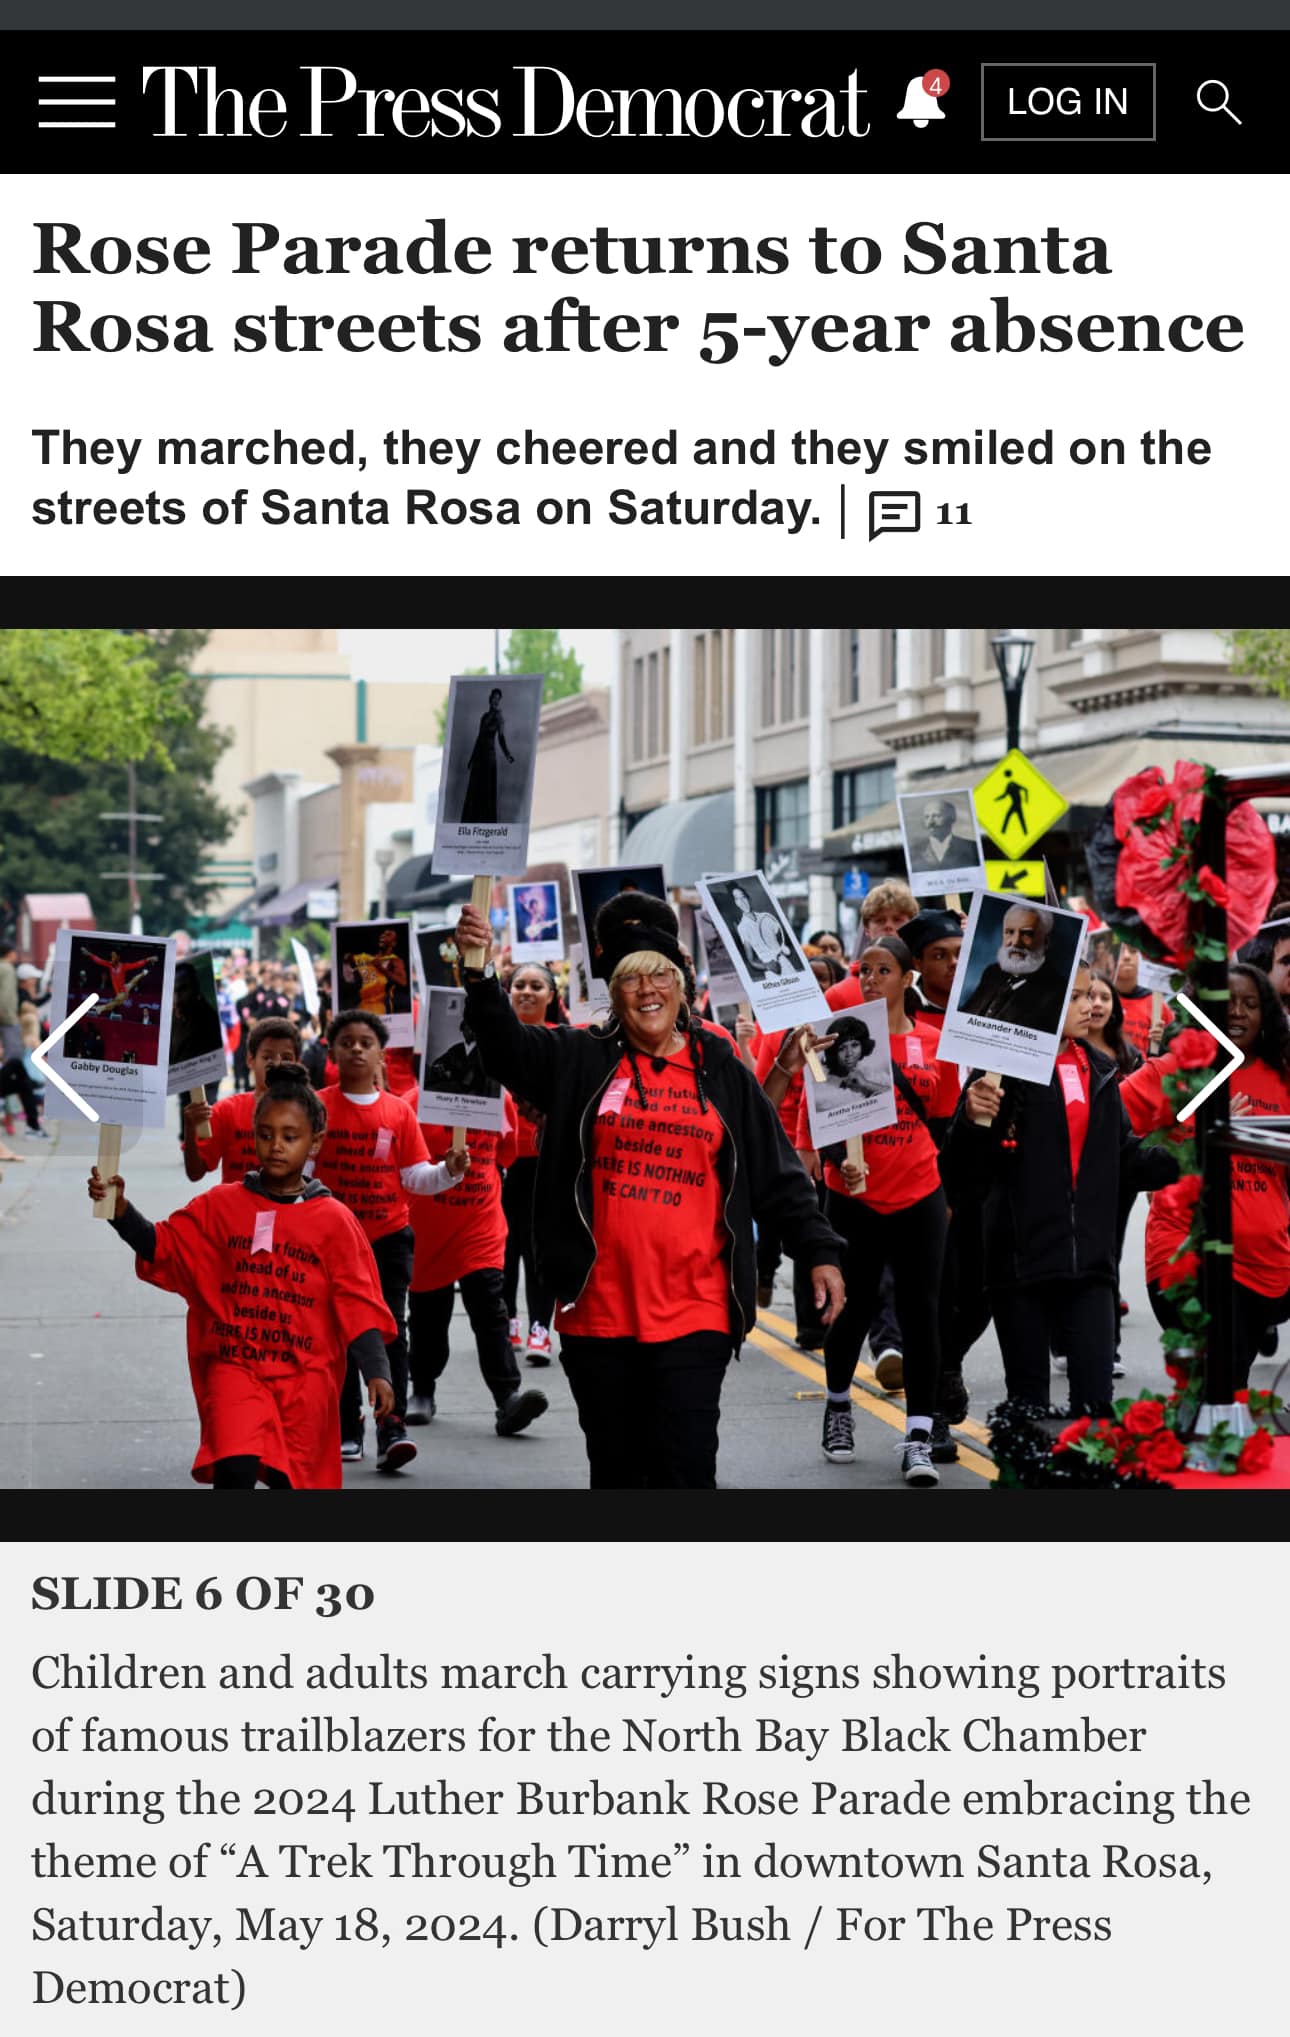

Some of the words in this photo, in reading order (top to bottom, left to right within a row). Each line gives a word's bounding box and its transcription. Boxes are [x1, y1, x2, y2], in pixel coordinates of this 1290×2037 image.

[457, 826, 471, 836] Ella
[472, 826, 508, 838] Fitzgerald
[967, 1017, 1012, 1034] Alexander
[1013, 1027, 1038, 1041] Miles
[71, 1061, 100, 1074] Gabby
[102, 1064, 139, 1076] Douglas
[597, 1115, 615, 1126] nd
[620, 1116, 644, 1130] the
[648, 1119, 714, 1142] ancestors
[615, 1136, 662, 1155] beside
[666, 1146, 684, 1159] us
[628, 1160, 641, 1176] IS
[644, 1164, 706, 1187] NOTHING
[620, 1183, 661, 1202] CAN'T
[663, 1190, 682, 1207] DO
[235, 1259, 273, 1276] ahead
[275, 1264, 290, 1280] of
[292, 1272, 306, 1284] us
[239, 1281, 259, 1297] the
[234, 1303, 277, 1321] beside
[245, 1327, 258, 1341] IS
[219, 1343, 238, 1358] WE
[241, 1345, 279, 1361] CAN'T
